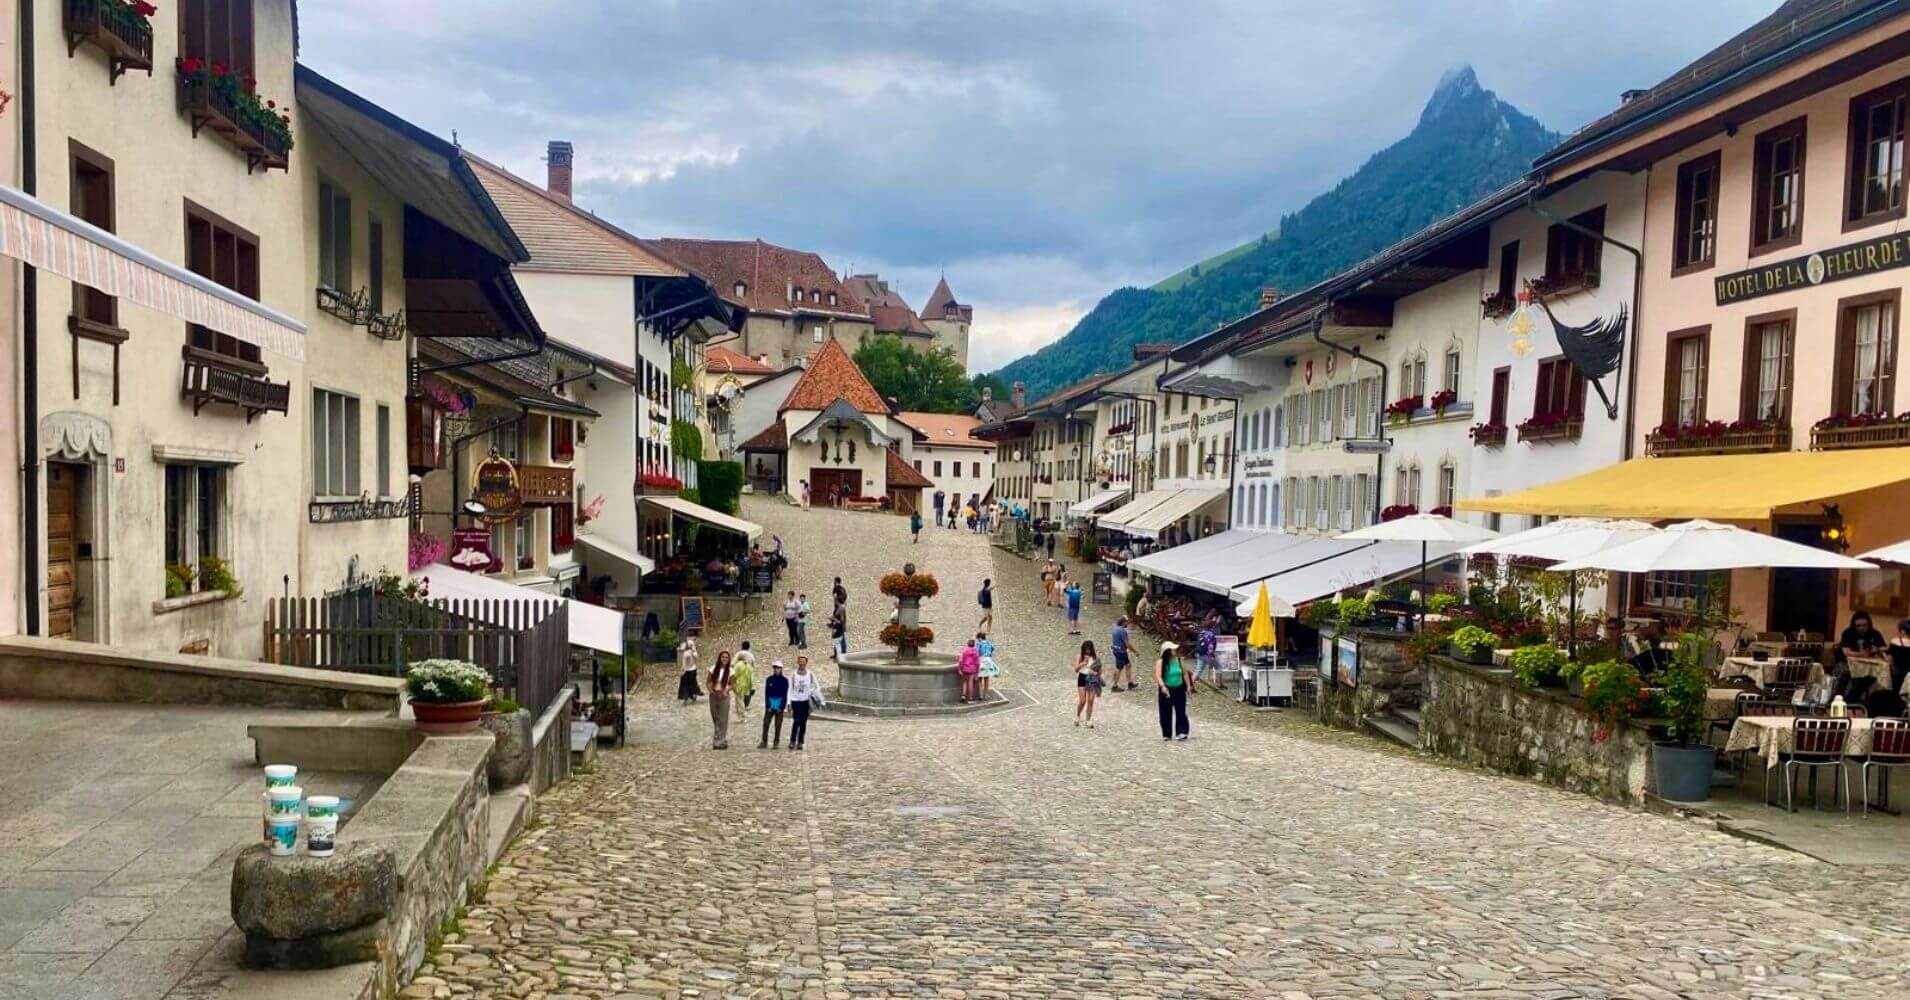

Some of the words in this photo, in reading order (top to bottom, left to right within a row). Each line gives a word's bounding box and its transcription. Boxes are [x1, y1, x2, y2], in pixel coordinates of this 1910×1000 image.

[1717, 273, 1762, 300] HOTEL
[1765, 267, 1784, 291] DE
[1786, 264, 1805, 286] LA
[1826, 245, 1881, 278] FLEUR
[1880, 239, 1903, 265] DE
